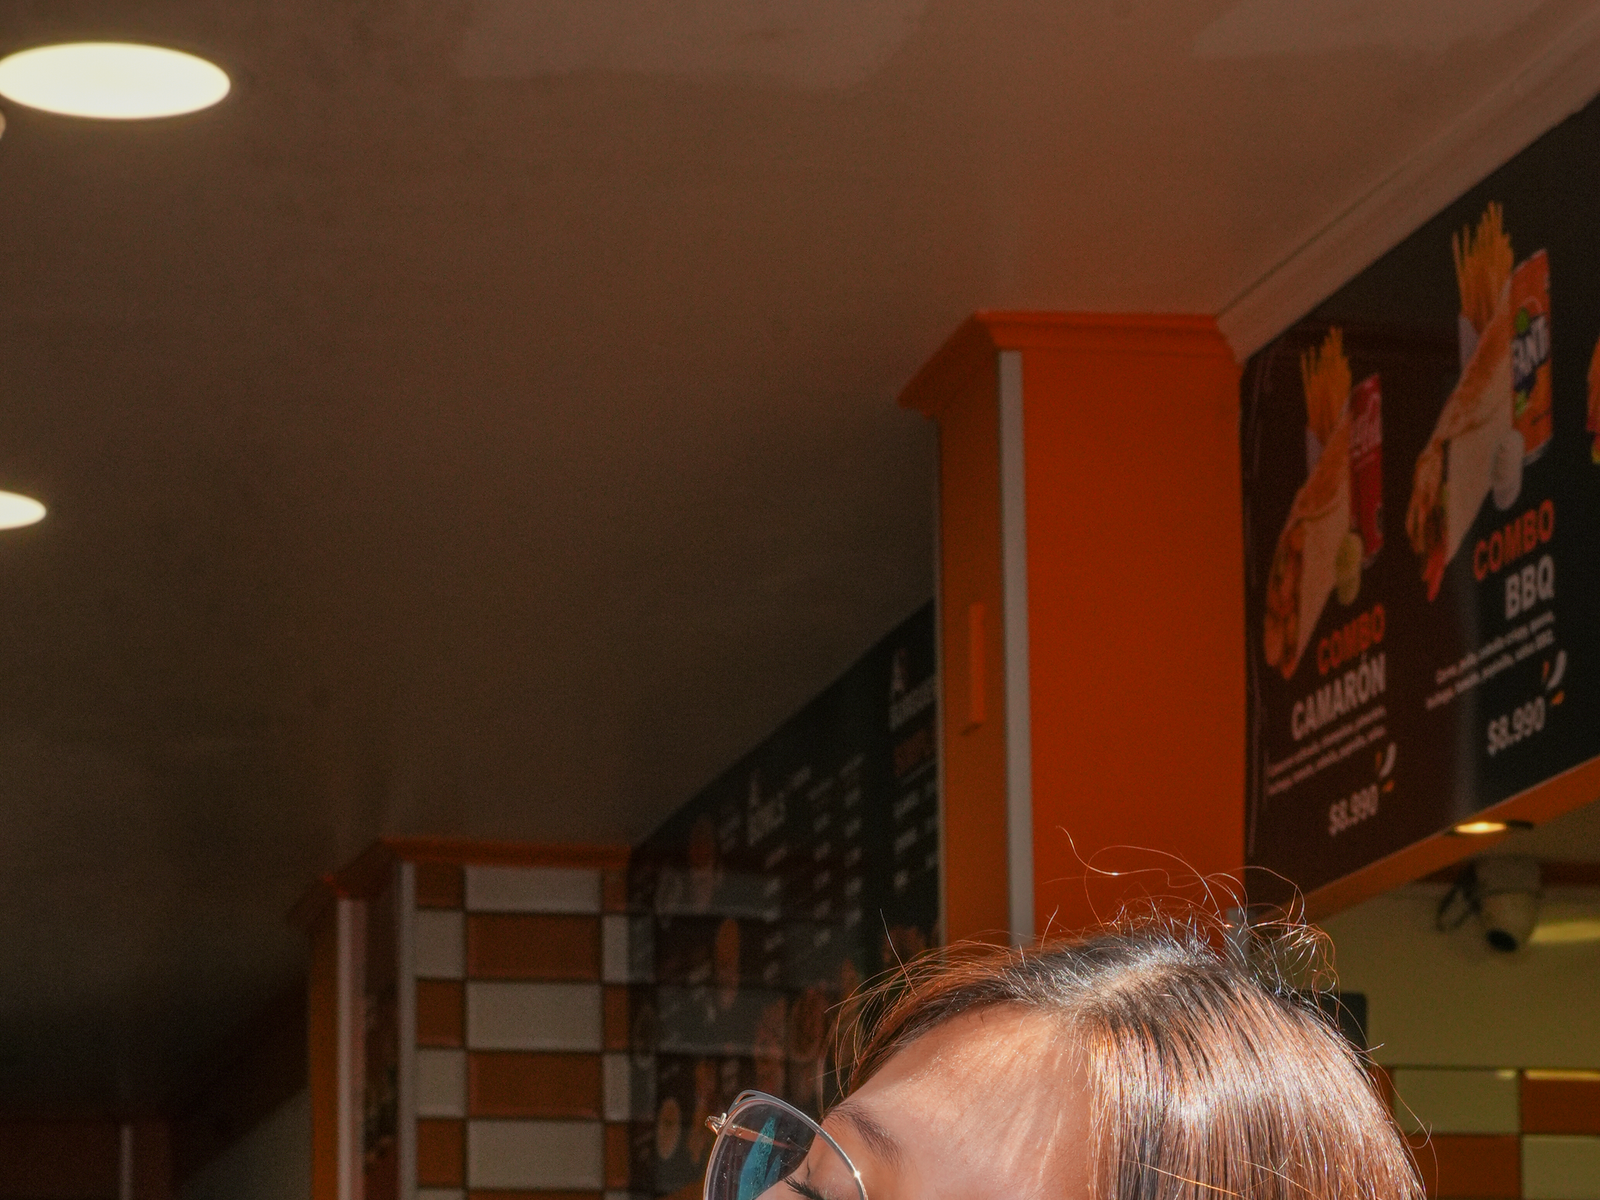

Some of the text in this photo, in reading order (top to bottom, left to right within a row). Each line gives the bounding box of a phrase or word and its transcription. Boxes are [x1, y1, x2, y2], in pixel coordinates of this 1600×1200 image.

[1473, 501, 1554, 581] COMBO
[1505, 555, 1554, 620] BBQ
[1317, 604, 1386, 675] COMBO
[1292, 652, 1386, 741] CAMARÓN
[1487, 696, 1546, 756] $8.990
